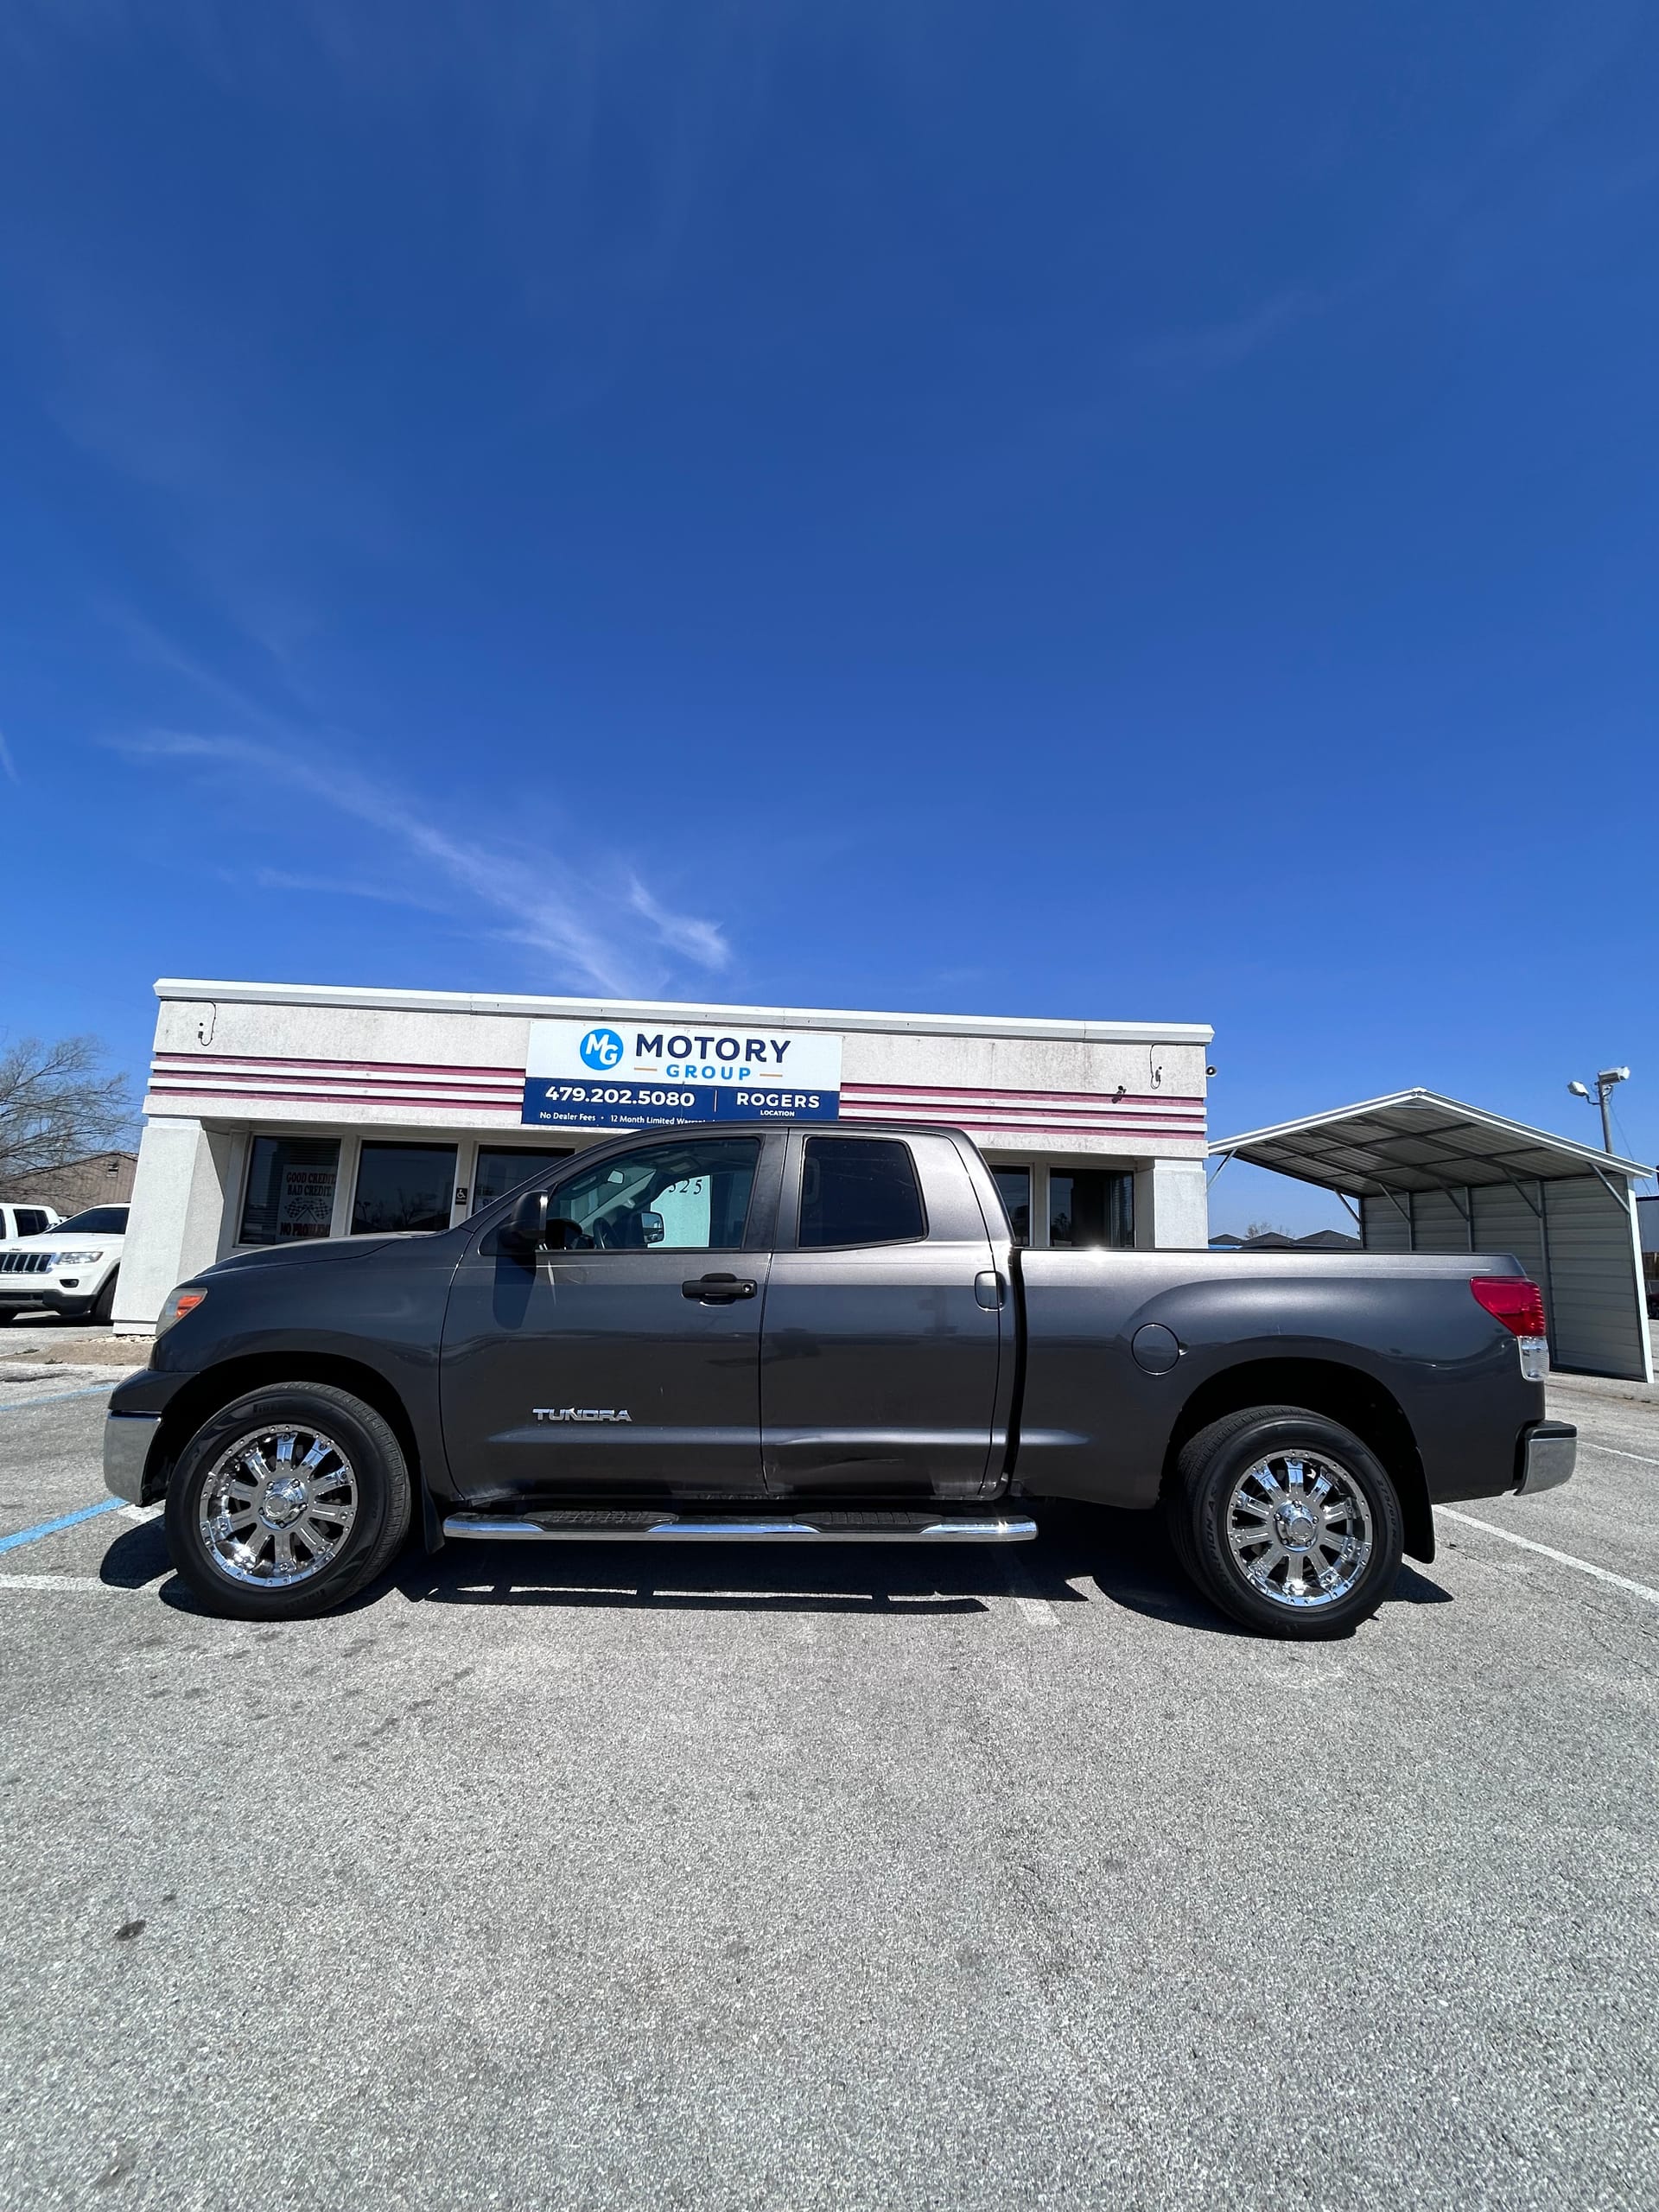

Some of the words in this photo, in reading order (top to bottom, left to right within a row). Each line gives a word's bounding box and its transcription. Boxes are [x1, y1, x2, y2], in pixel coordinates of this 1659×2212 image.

[585, 1033, 619, 1065] MG
[635, 1033, 791, 1064] MOTORY
[665, 1064, 751, 1081] GROUP
[545, 1086, 696, 1107] 479.202.5080
[736, 1092, 820, 1109] ROGERS
[553, 1111, 577, 1120] Dealer
[579, 1113, 596, 1122] Fees
[620, 1115, 645, 1123] Month
[646, 1116, 675, 1125] Limited
[286, 1172, 307, 1183] GOOD
[287, 1185, 303, 1196] BAD
[279, 1222, 292, 1236] NO
[532, 1407, 632, 1422] TUNDRA
